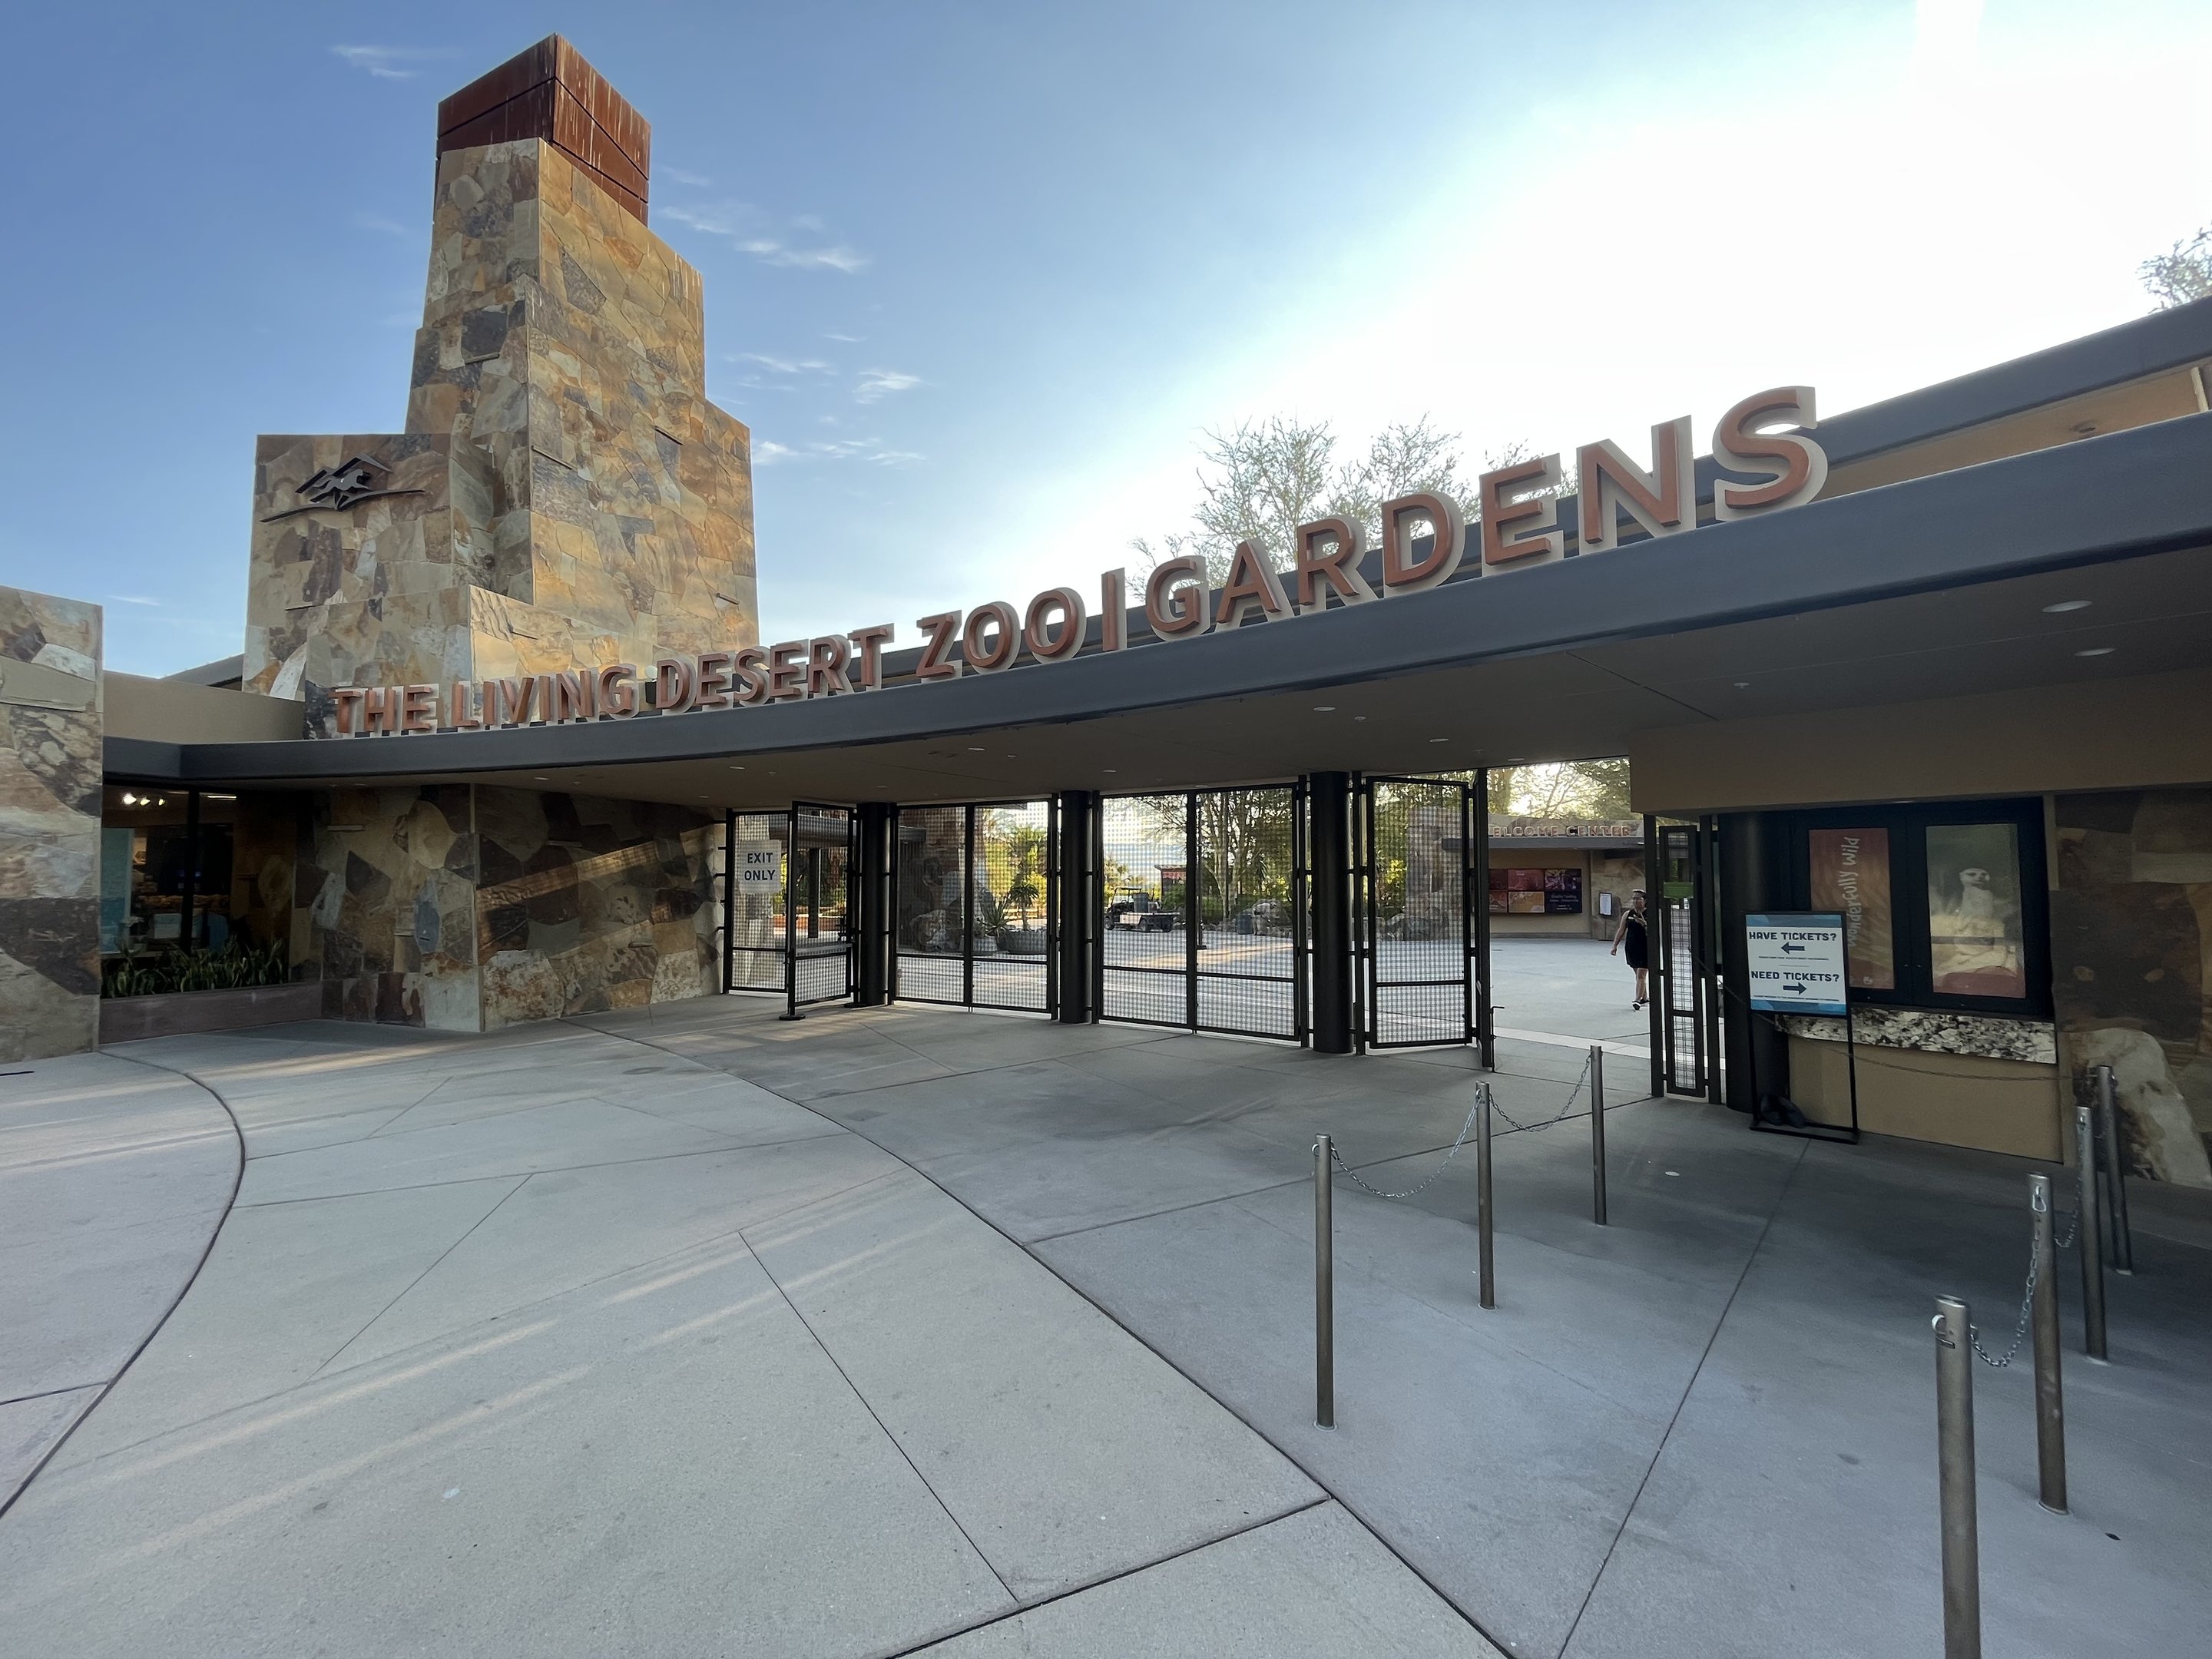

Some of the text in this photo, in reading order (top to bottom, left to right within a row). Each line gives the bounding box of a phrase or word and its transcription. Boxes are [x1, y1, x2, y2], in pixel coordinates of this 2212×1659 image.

[329, 683, 438, 735] THE
[451, 664, 638, 732] LIVING
[655, 623, 894, 716] DESERT
[1488, 825, 1631, 837] ELCOME CENTER
[1841, 836, 1860, 866] Wild
[747, 852, 773, 864] EXIT
[743, 869, 776, 882] ONLY
[1748, 932, 1837, 942] HAVE TICKETS?
[1750, 971, 1840, 982] NEED TICKETS?
